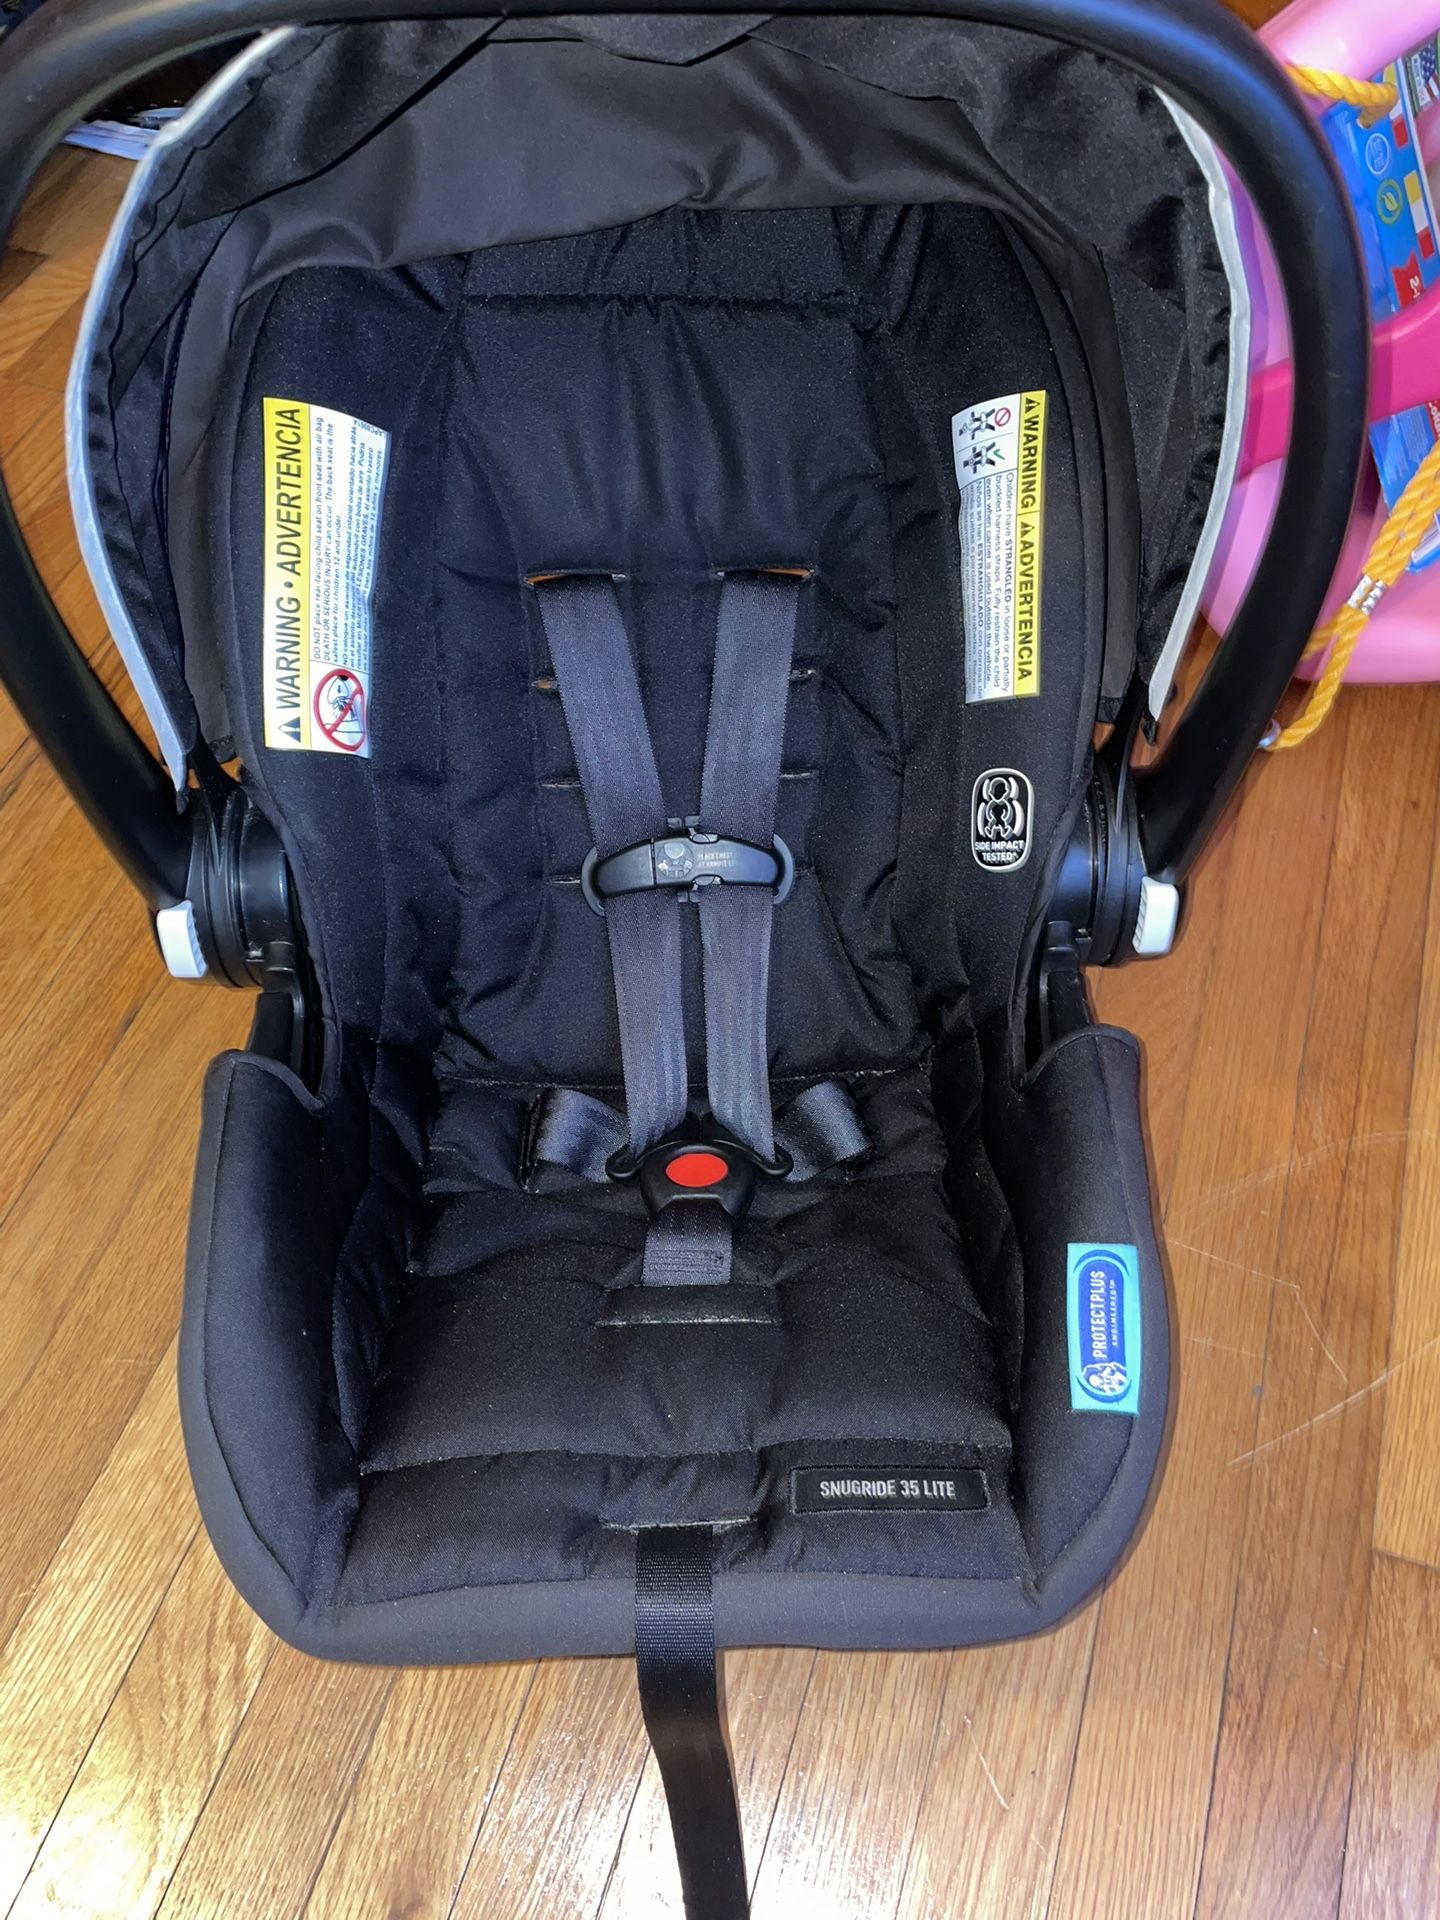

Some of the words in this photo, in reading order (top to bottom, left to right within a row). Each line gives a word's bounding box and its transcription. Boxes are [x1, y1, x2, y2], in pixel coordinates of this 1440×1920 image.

[1020, 415, 1039, 508] WARNING
[275, 408, 302, 576] ADVERTENCIA
[357, 486, 363, 495] de
[1006, 472, 1014, 512] Children
[317, 505, 322, 514] on
[314, 536, 322, 555] child
[334, 557, 340, 565] 12
[356, 548, 367, 587] LESIONES
[1004, 539, 1012, 602] STRANGLED
[323, 579, 331, 616] SERIOUS
[993, 588, 1001, 609] Fully
[1004, 606, 1011, 614] in
[1017, 540, 1034, 680] ADVERTENCIA
[323, 619, 329, 630] OR
[1003, 616, 1011, 641] loose
[275, 596, 302, 709] WARNING
[314, 647, 320, 659] DO
[342, 653, 348, 665] NO
[1004, 644, 1010, 654] or
[1001, 656, 1010, 692] partially
[975, 841, 990, 850] SIDE
[992, 840, 1024, 850] IMPACT
[1090, 1270, 1107, 1358] PROTECTPLUS
[820, 1480, 896, 1497] SNUGRIDE
[901, 1480, 920, 1497] 35
[923, 1480, 956, 1498] LITE
